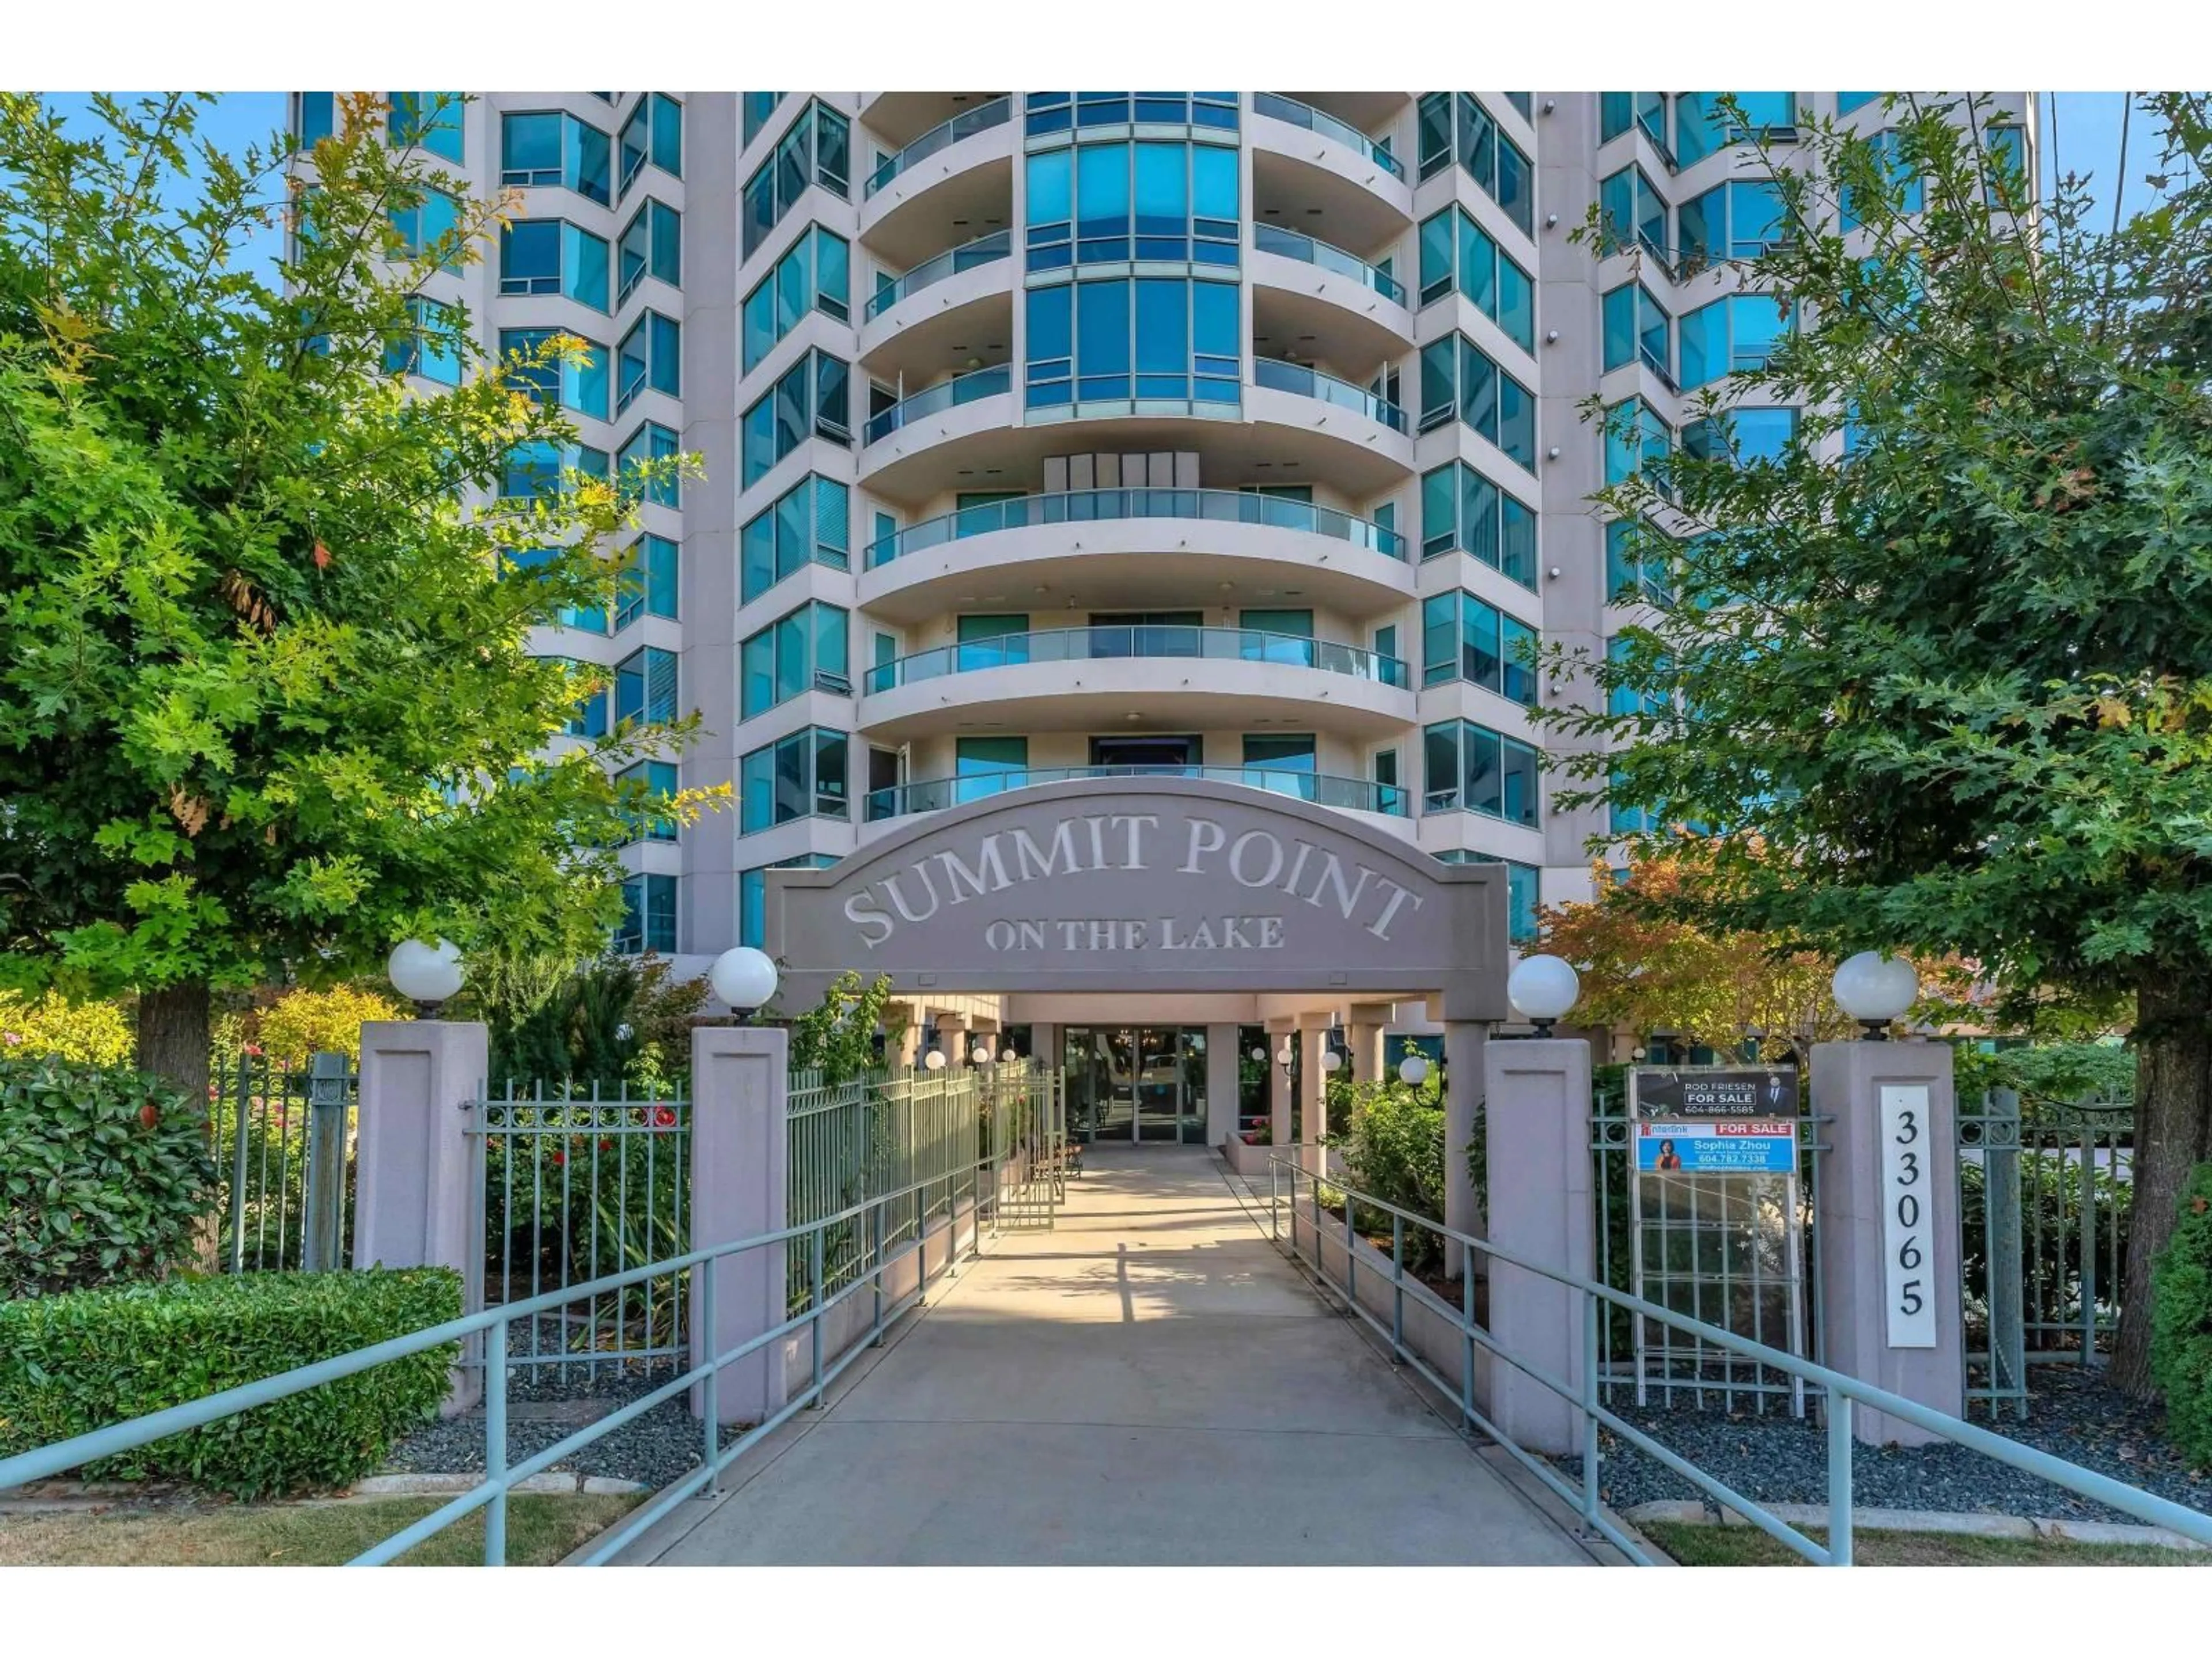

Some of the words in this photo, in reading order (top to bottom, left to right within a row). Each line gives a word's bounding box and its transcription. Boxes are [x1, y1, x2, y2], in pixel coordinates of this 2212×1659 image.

[844, 815, 1160, 949] SUMMIT
[1176, 817, 1425, 942] POINT
[986, 920, 1046, 952] ON
[1056, 920, 1149, 950] THE
[1159, 916, 1285, 950] LAKE
[1688, 1094, 1715, 1103] FOR
[1718, 1094, 1752, 1103] SALE
[1719, 1124, 1747, 1133] FOR
[1751, 1124, 1787, 1133] SALE
[1694, 1140, 1736, 1151] Sophia
[1739, 1140, 1770, 1150] Zhou
[1896, 1111, 1923, 1316] 33065
